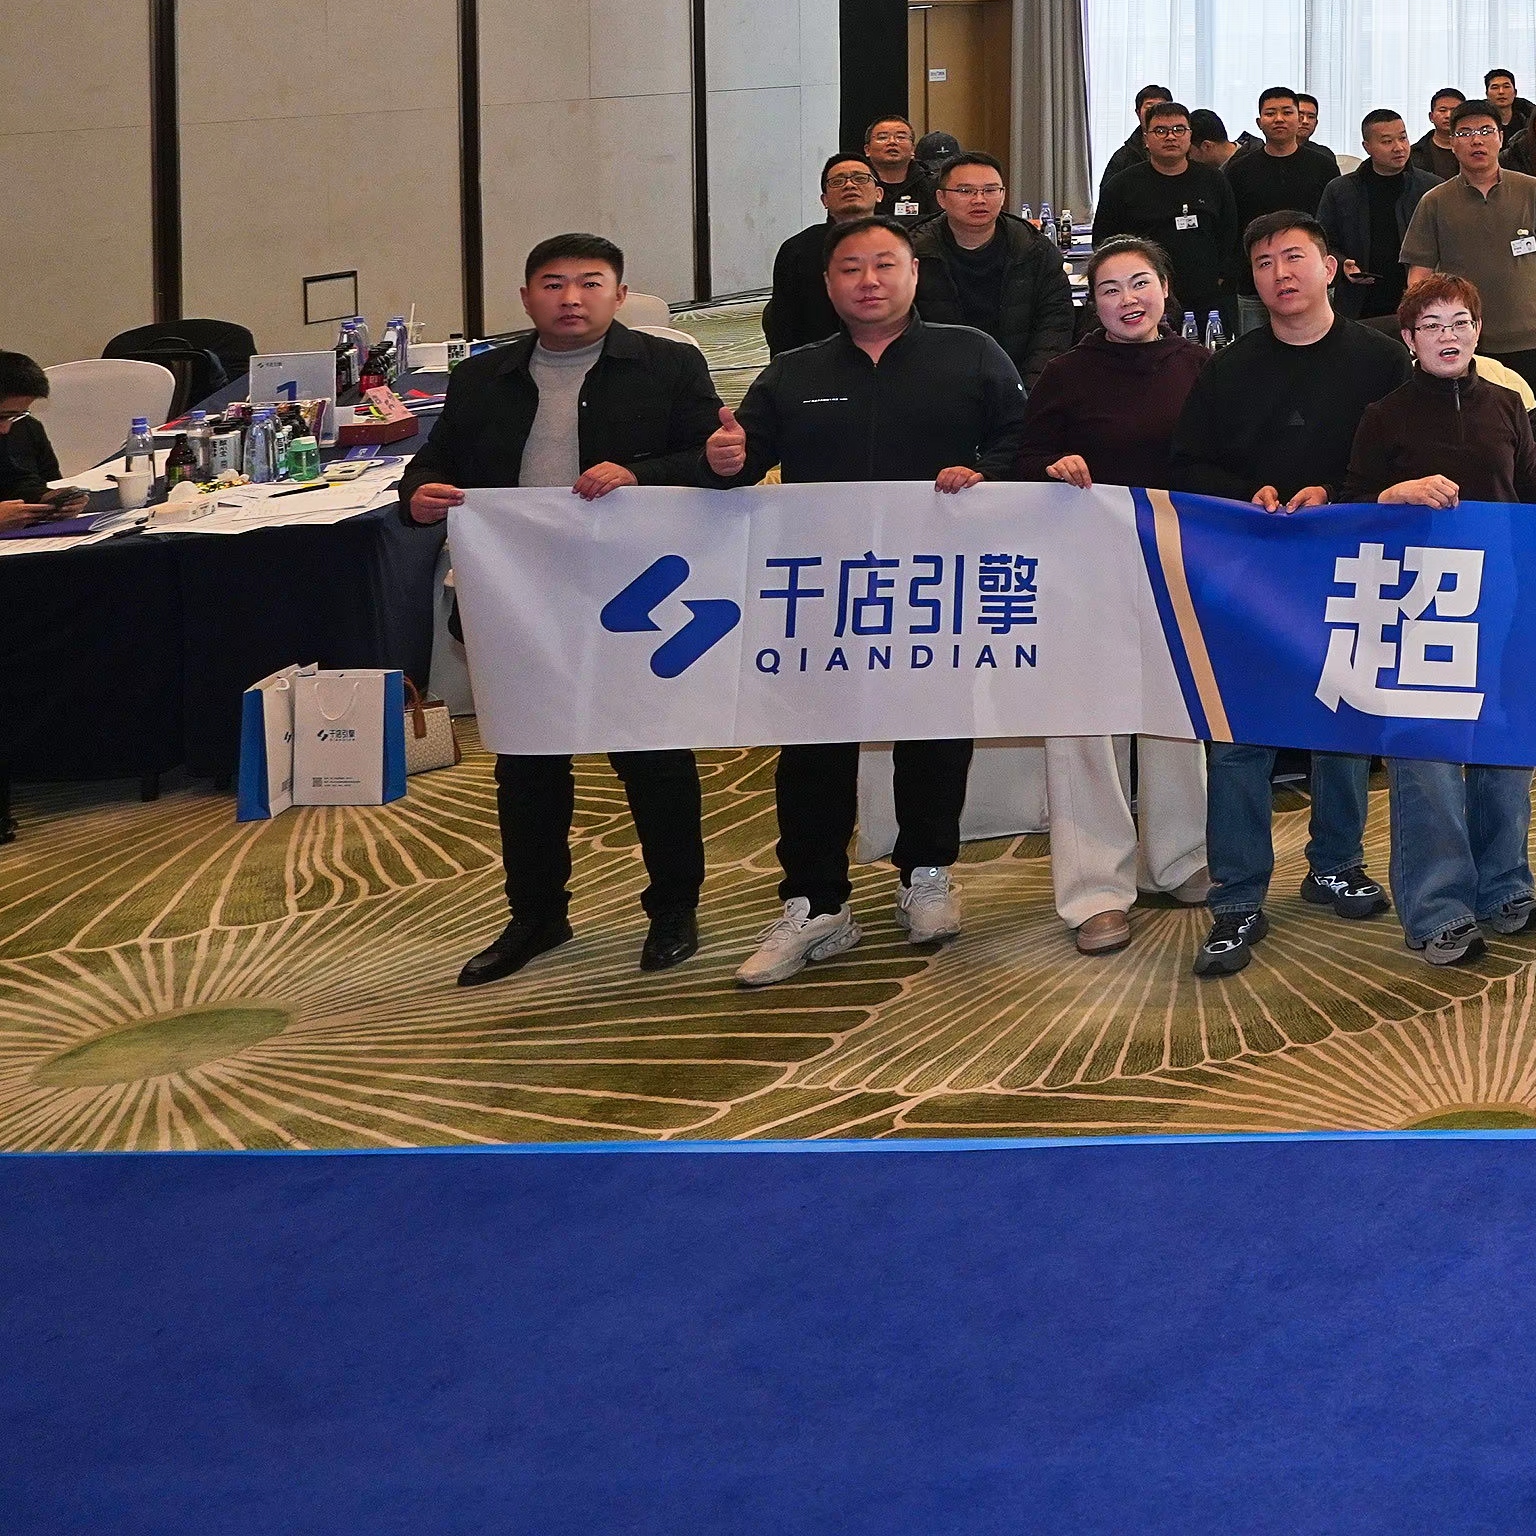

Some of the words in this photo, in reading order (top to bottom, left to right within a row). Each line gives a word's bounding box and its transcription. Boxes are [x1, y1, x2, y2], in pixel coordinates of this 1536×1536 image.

[759, 550, 1038, 639] 千店引擎
[756, 645, 1038, 675] QIANDIAN
